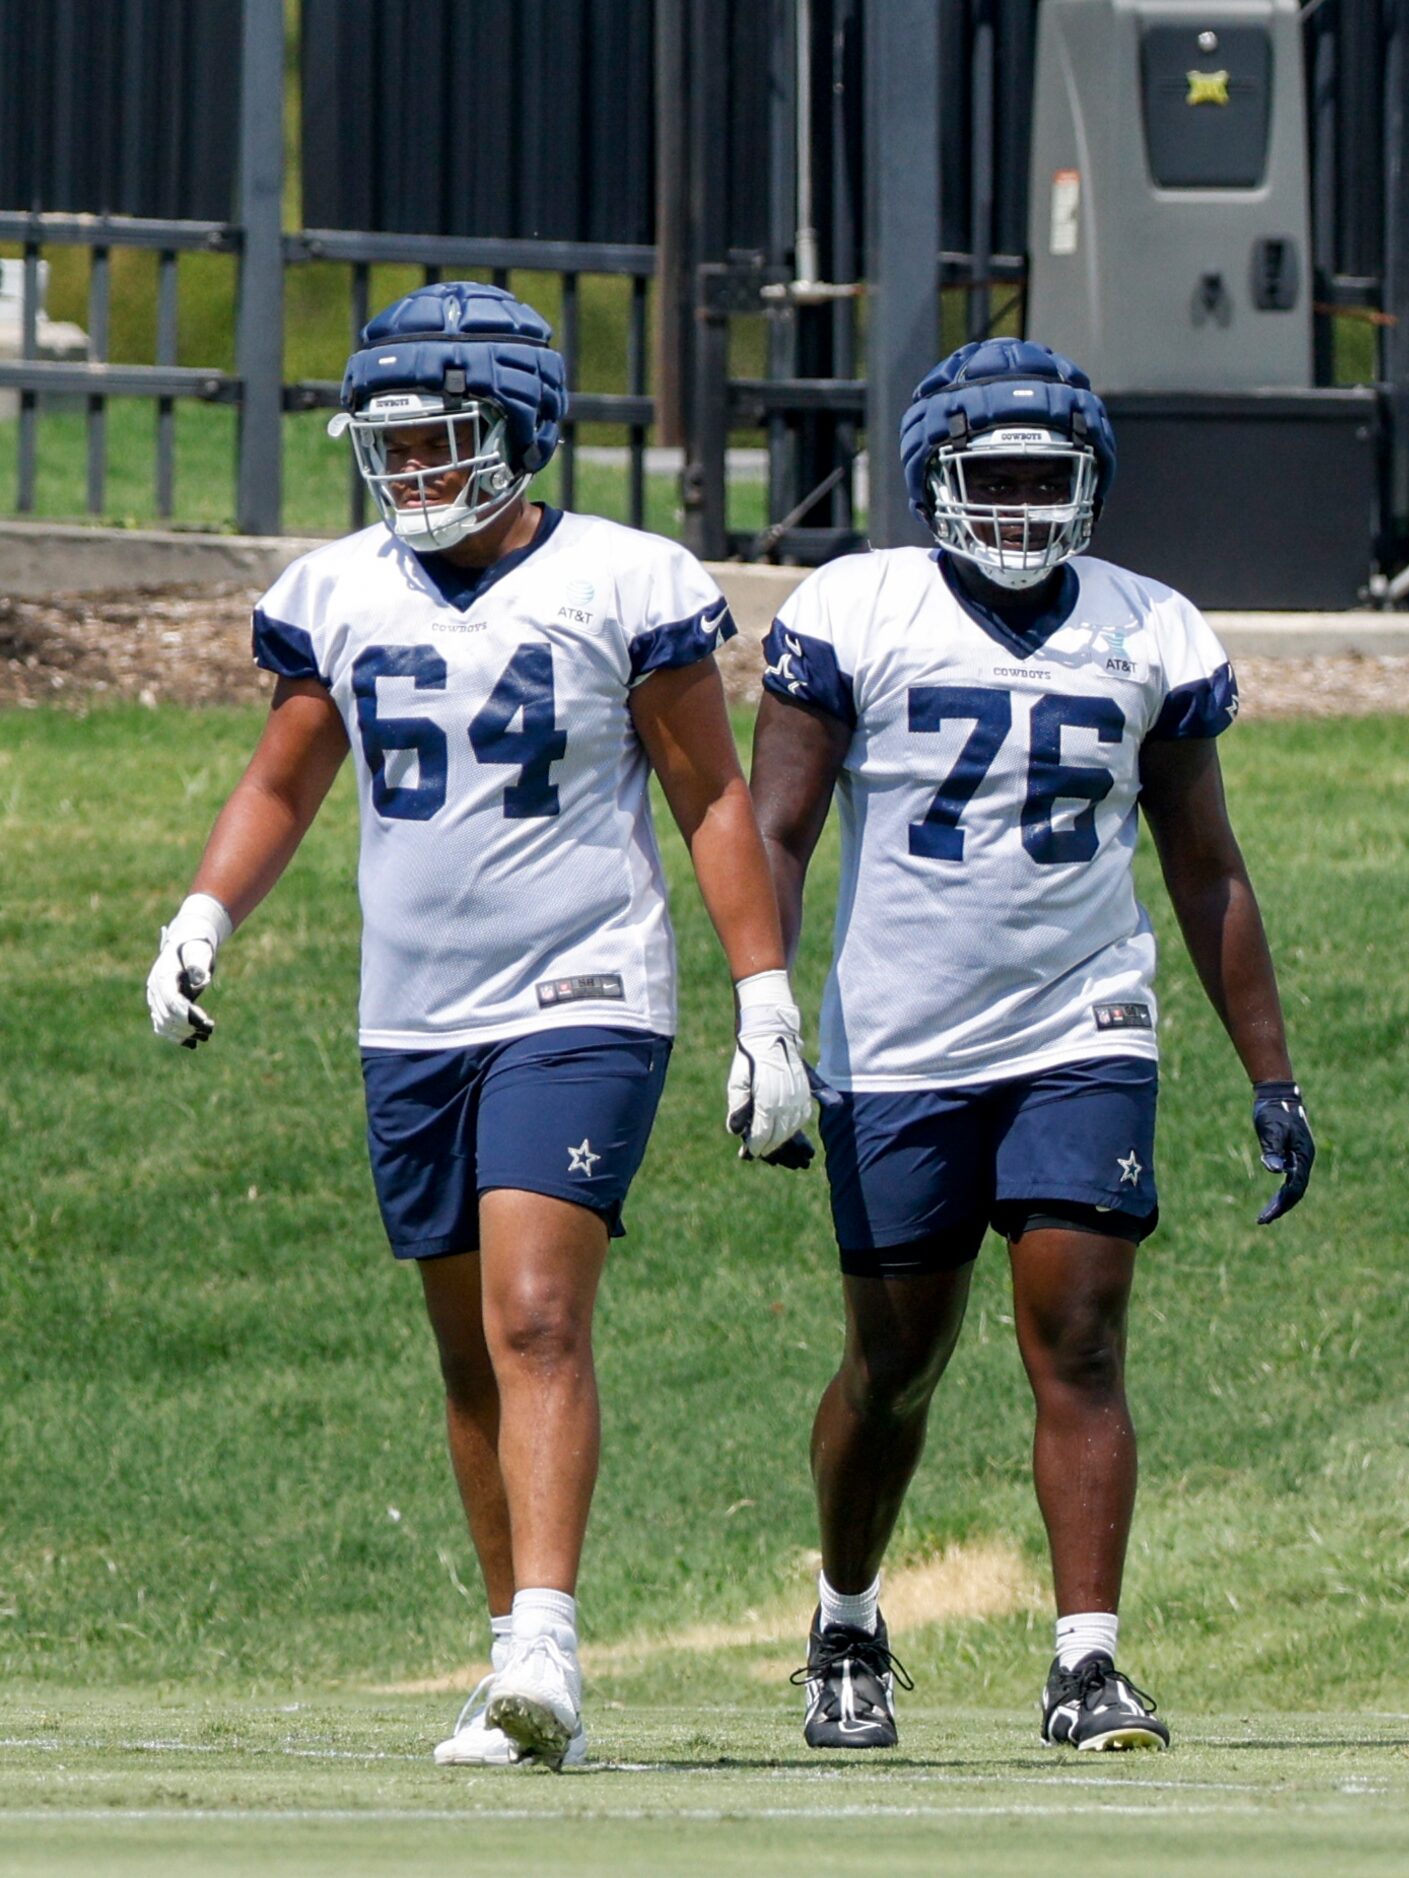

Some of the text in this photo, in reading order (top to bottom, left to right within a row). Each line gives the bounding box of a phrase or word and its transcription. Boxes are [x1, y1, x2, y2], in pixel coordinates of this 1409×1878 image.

[558, 606, 593, 625] AT&T
[432, 622, 487, 633] COWBOYS
[993, 667, 1051, 680] COWBOYS
[1106, 658, 1137, 674] AT&T
[352, 643, 567, 821] 64
[908, 686, 1126, 864] 76
